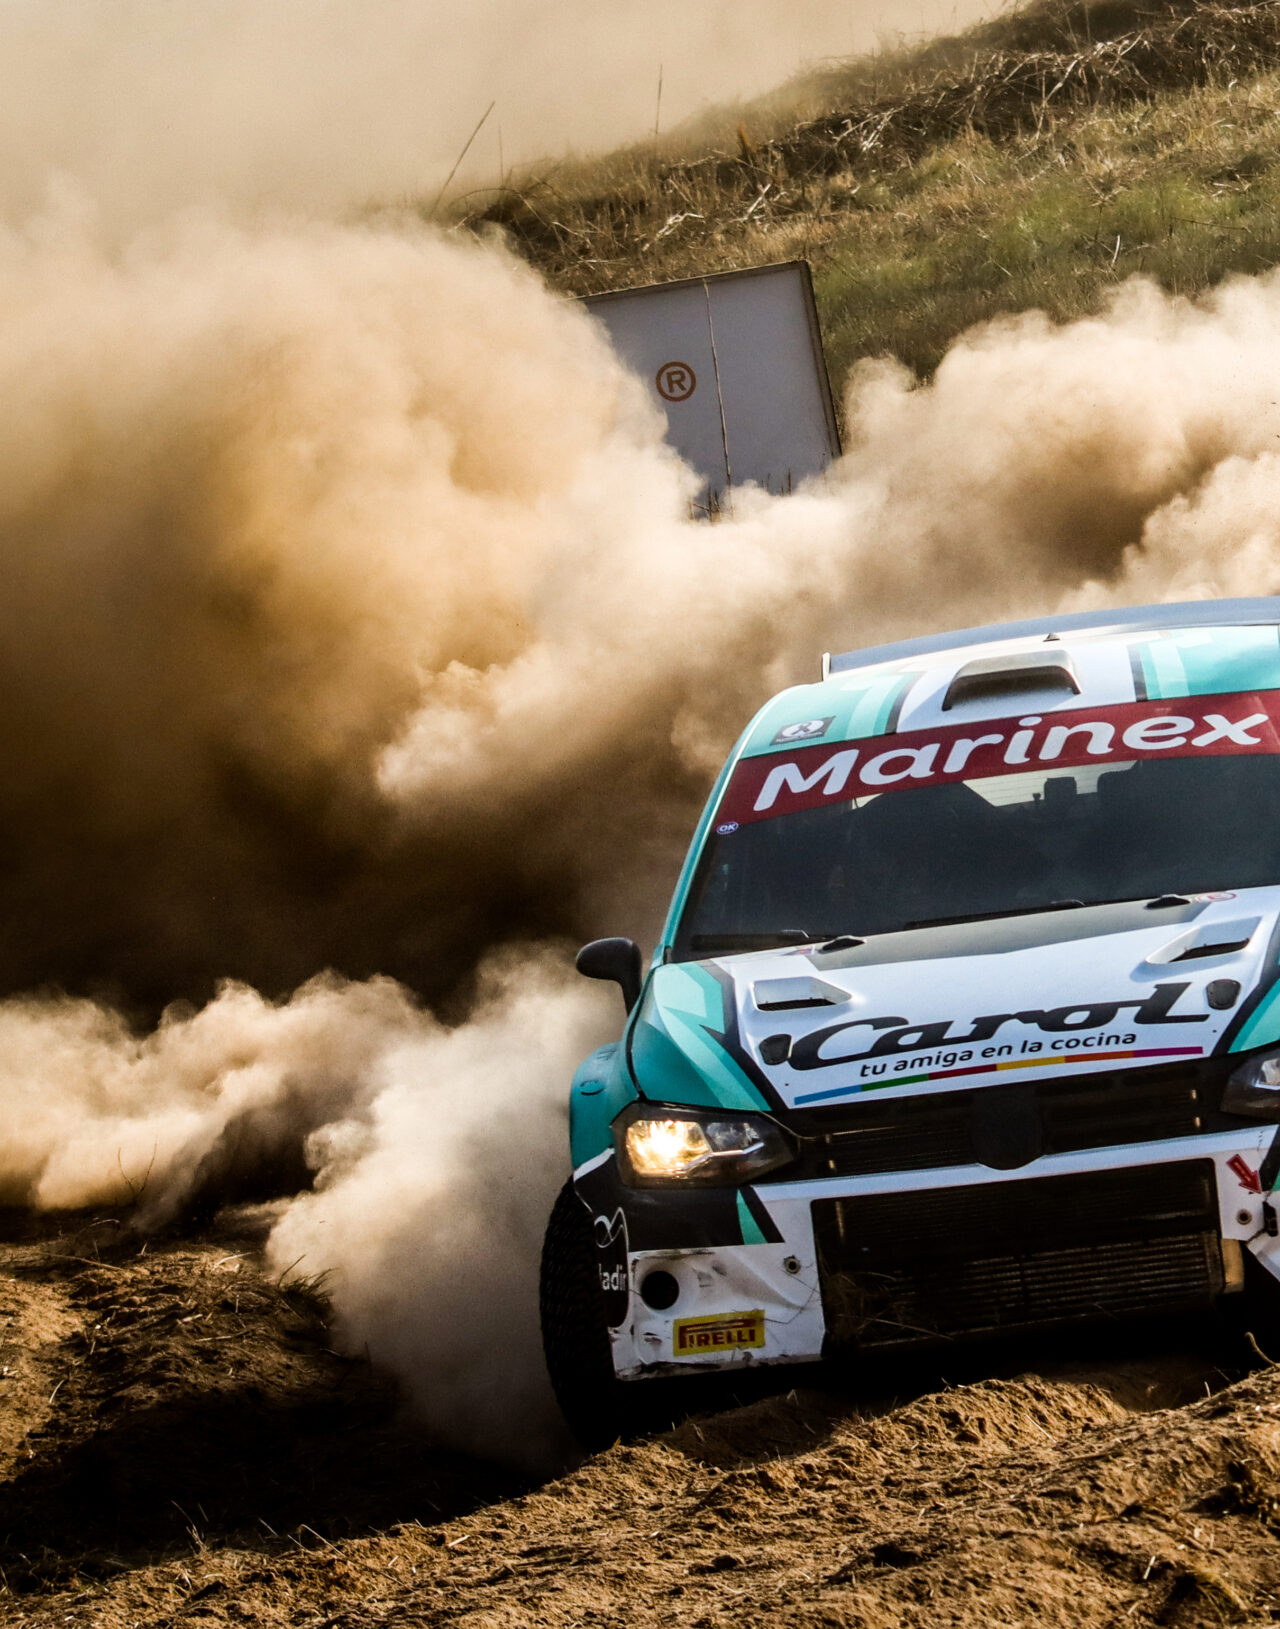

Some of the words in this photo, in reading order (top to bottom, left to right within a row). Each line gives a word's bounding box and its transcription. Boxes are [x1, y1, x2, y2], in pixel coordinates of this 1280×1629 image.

[753, 712, 1269, 812] Marinex
[720, 823, 736, 832] OK
[787, 981, 1210, 1071] Carol
[859, 1064, 887, 1078] tu
[893, 1050, 974, 1072] amiga
[980, 1045, 1013, 1059] en
[1019, 1039, 1043, 1054] la
[1050, 1032, 1137, 1051] cocina
[678, 1317, 757, 1350] PIRELLI
